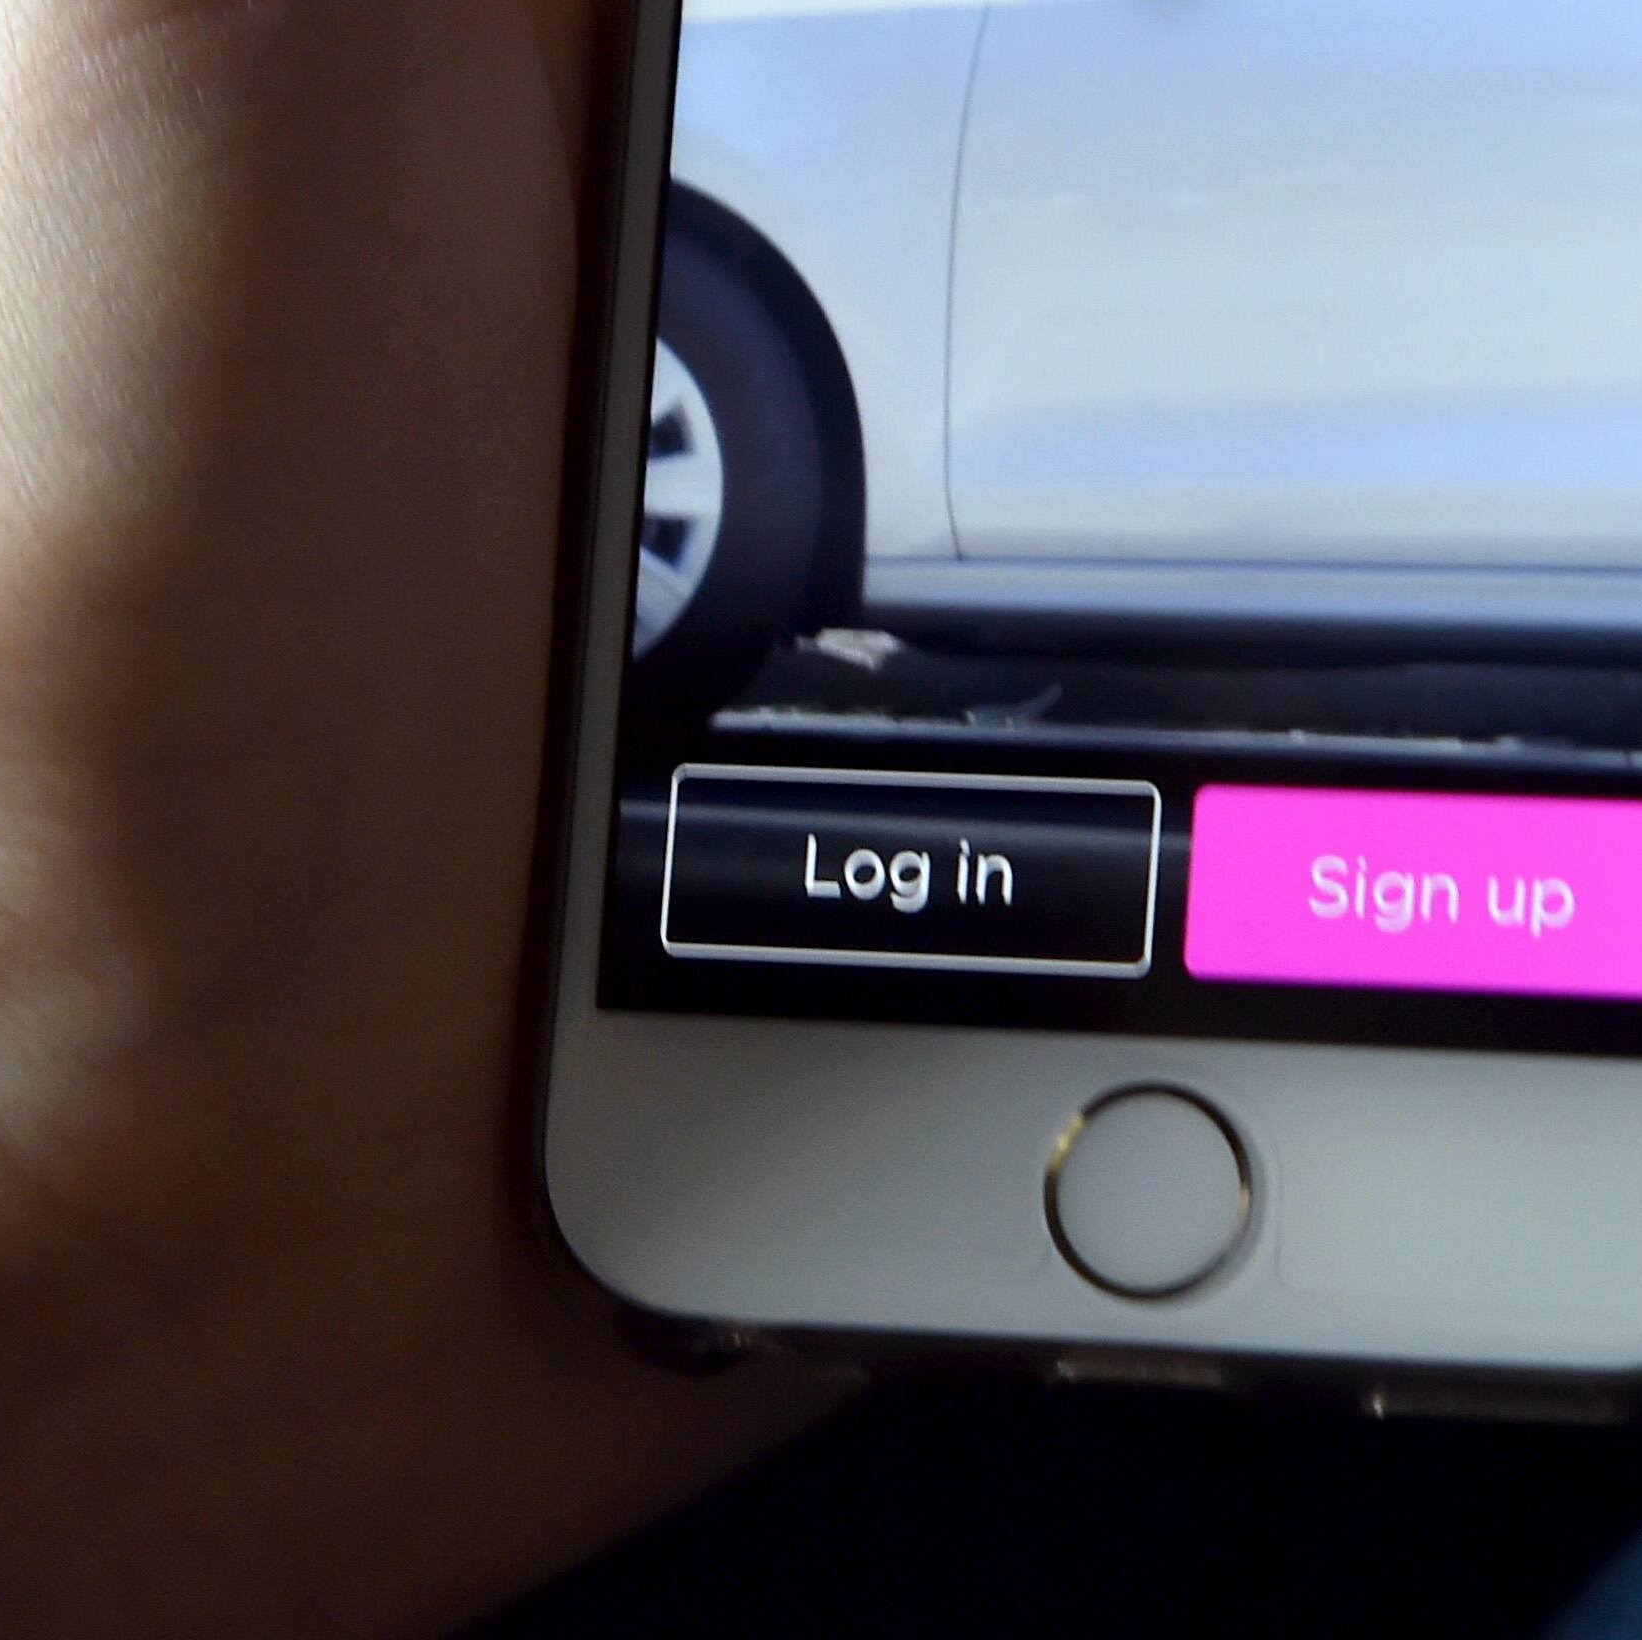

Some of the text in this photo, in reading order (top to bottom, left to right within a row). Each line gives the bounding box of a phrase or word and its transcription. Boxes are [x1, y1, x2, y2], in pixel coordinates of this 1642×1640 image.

[804, 834, 1013, 912] Log in
[1307, 853, 1577, 940] Sign up
